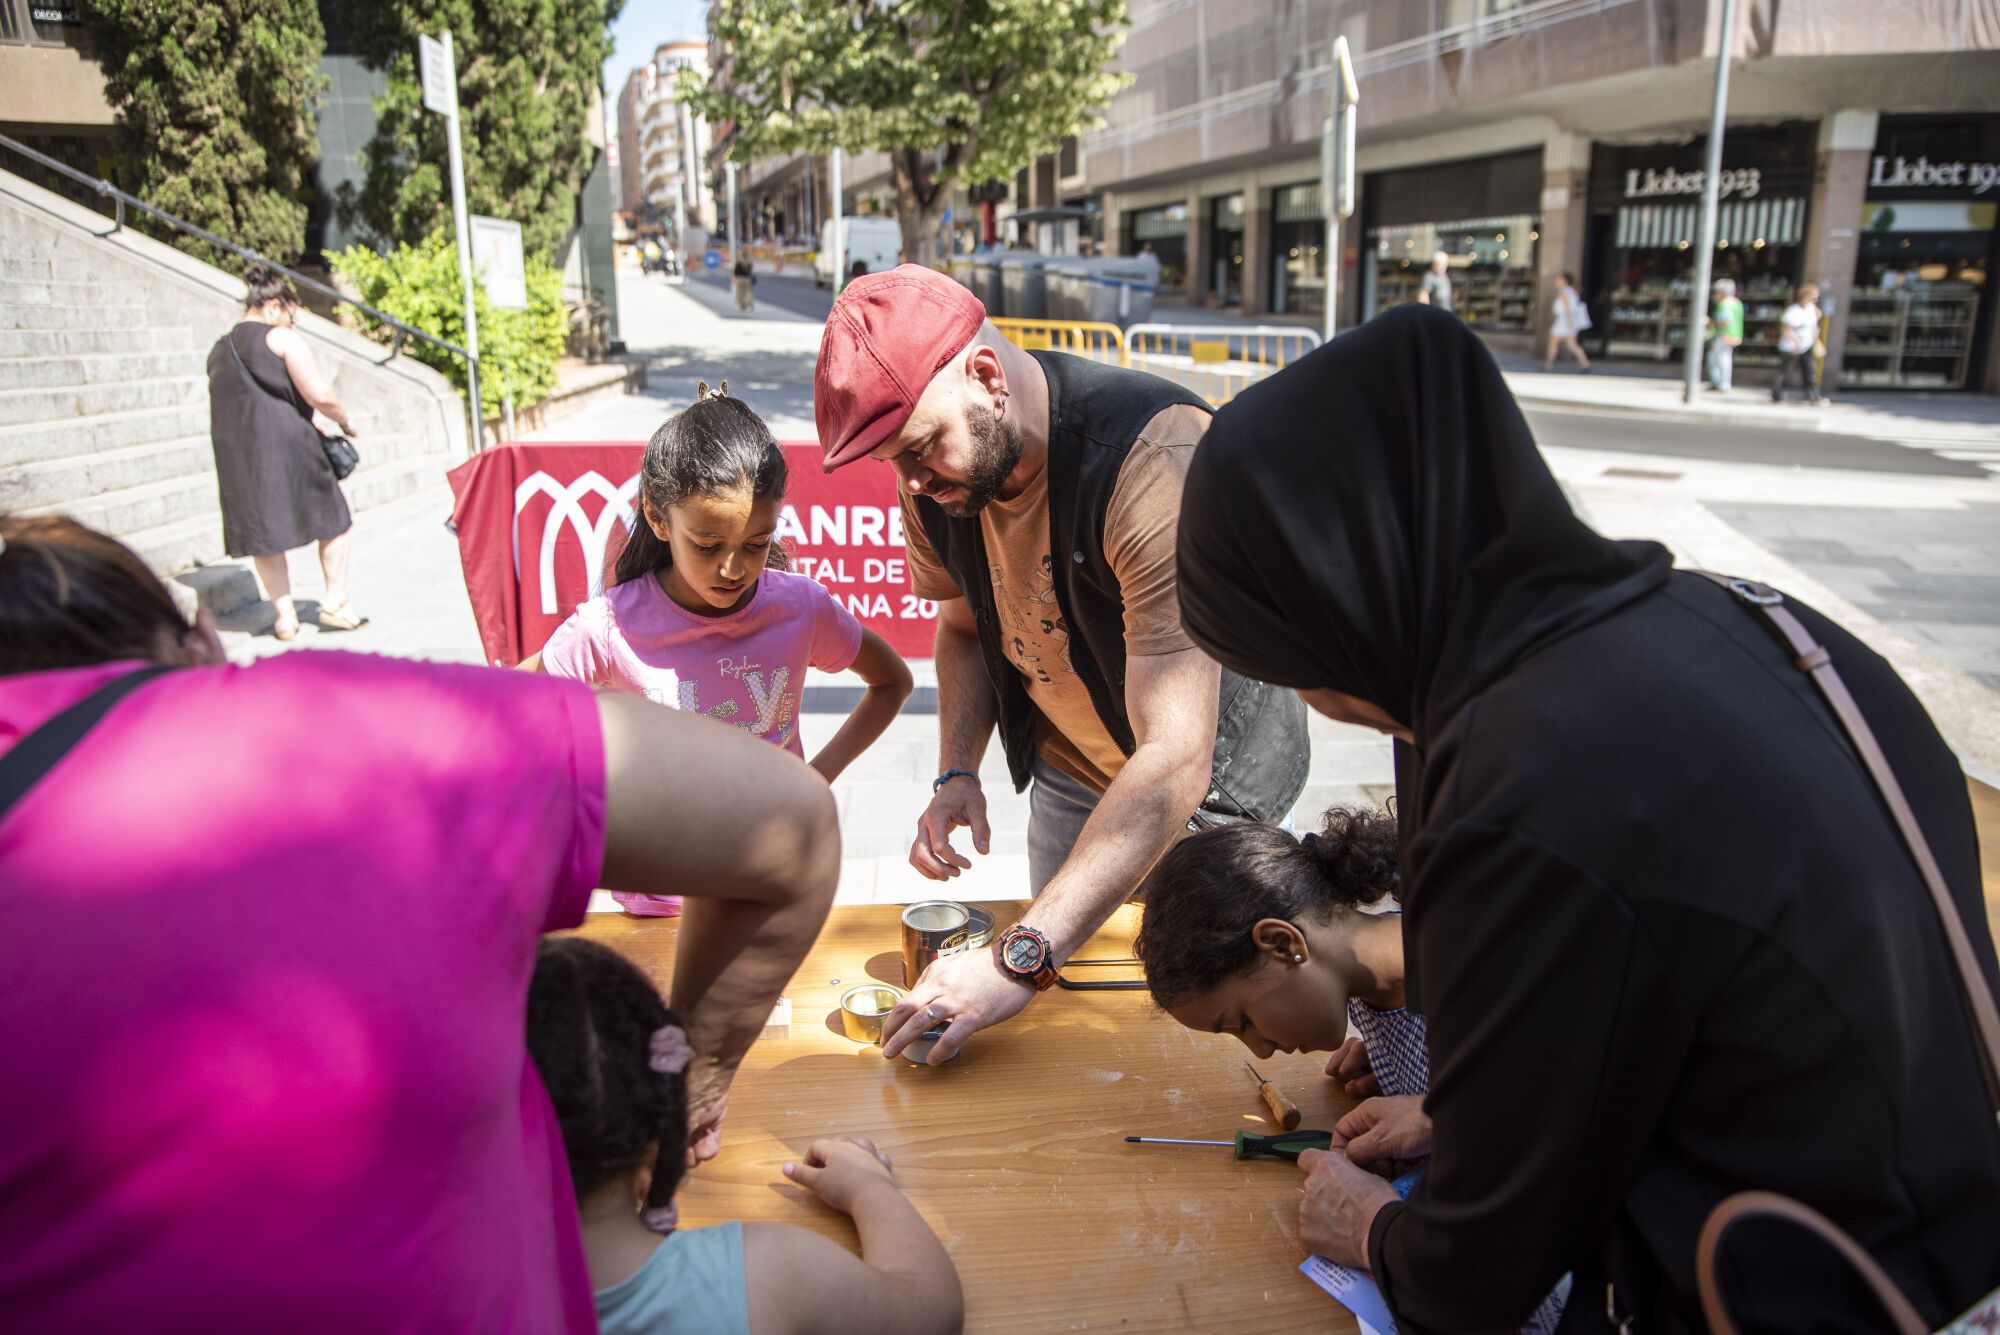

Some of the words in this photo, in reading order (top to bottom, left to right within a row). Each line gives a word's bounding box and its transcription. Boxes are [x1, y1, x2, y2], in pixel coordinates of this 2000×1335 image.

[1625, 167, 1707, 198] Llobet
[1718, 168, 1761, 199] 923
[1870, 155, 1966, 187] Llobet
[1967, 161, 2000, 195] 19
[775, 504, 906, 547] ANRE
[863, 558, 906, 584] DE
[900, 594, 940, 619] 20
